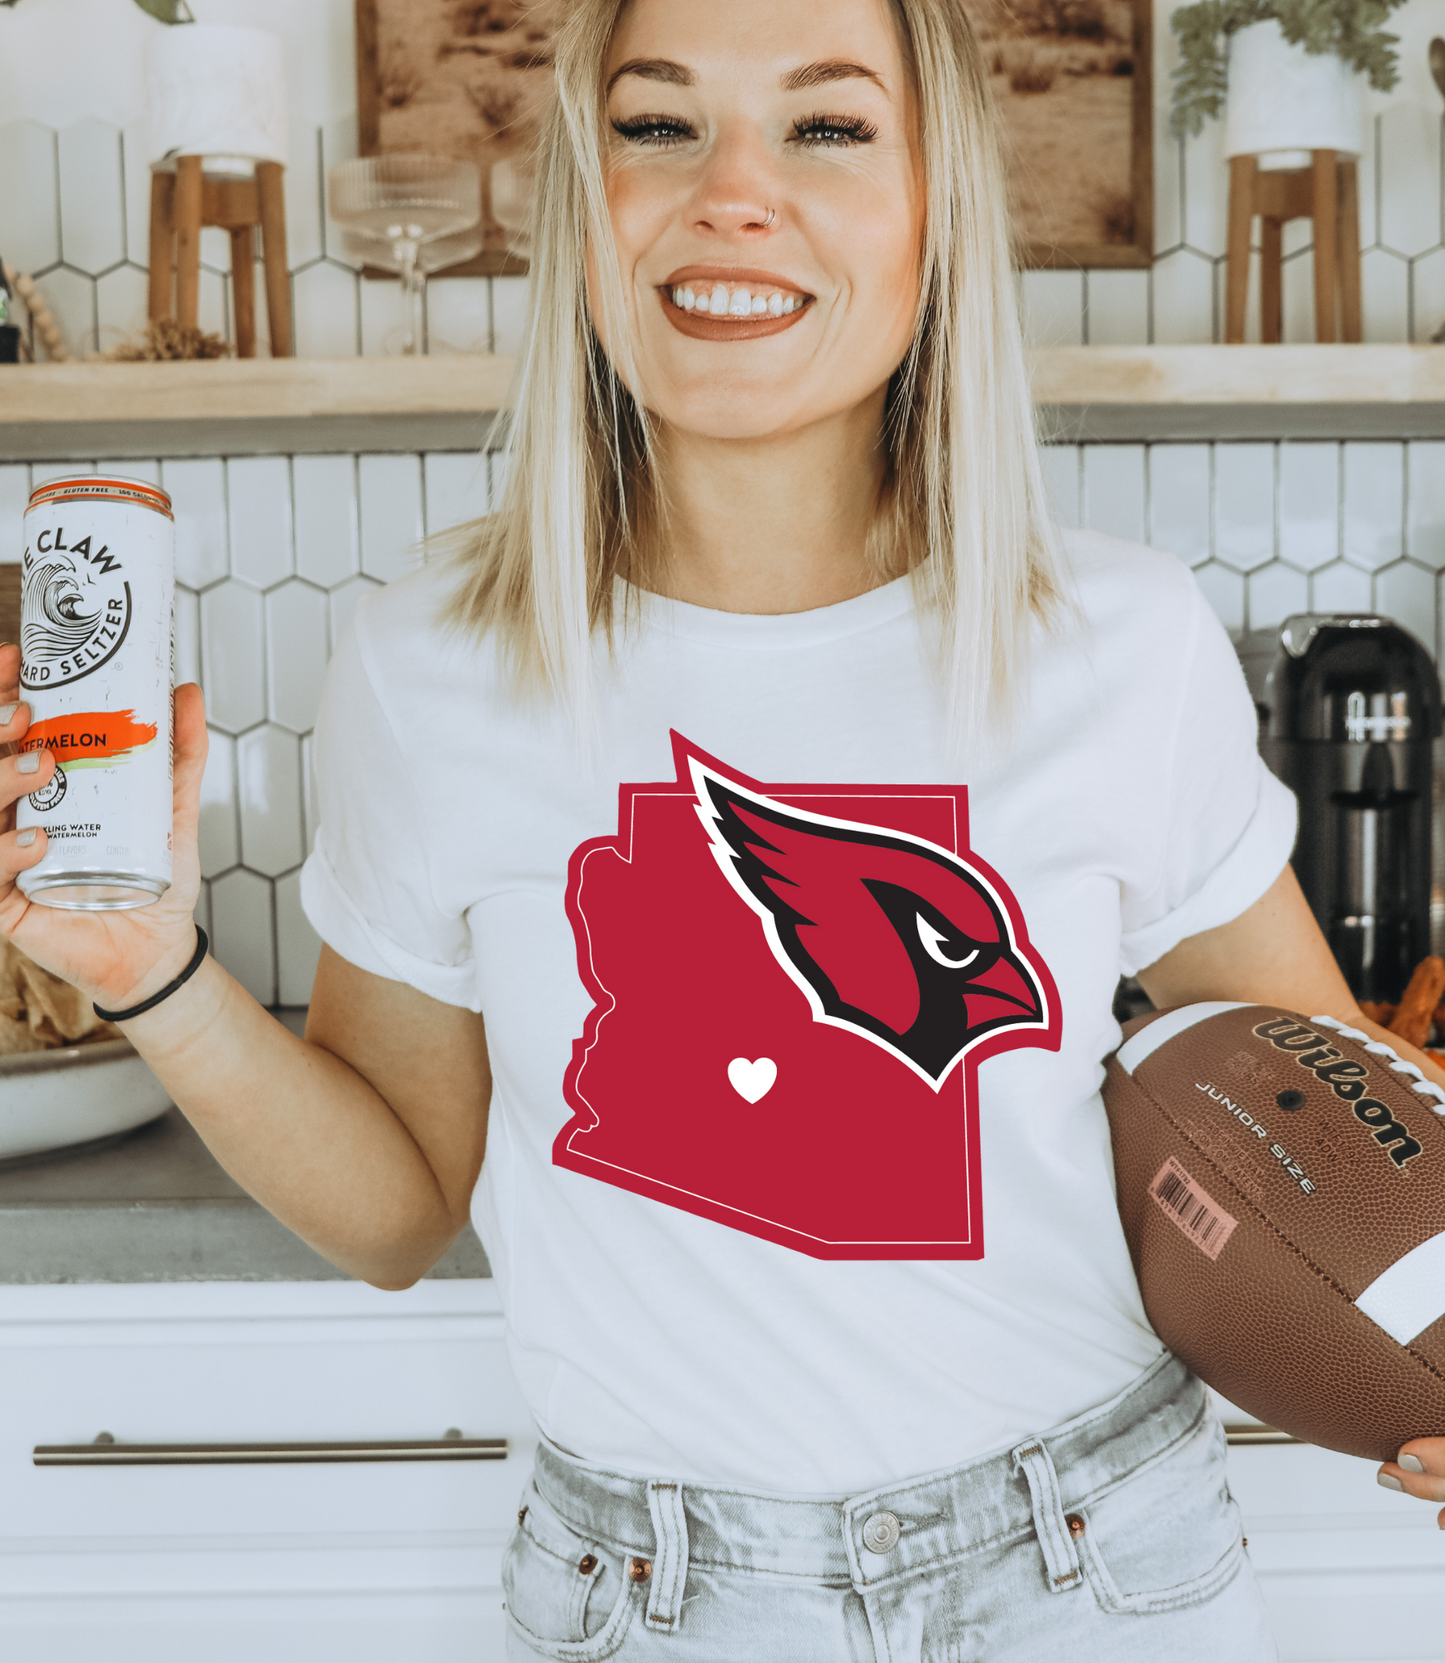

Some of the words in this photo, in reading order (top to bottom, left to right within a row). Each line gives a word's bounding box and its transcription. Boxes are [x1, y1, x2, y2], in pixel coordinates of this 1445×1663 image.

[37, 527, 122, 575] CLAW
[60, 599, 123, 675] SELTZER
[50, 788, 65, 808] FREE
[43, 825, 67, 834] KLING
[69, 823, 102, 833] WATER
[1252, 1015, 1422, 1168] Wilson
[1195, 1082, 1267, 1139] JUNIOR
[1270, 1143, 1316, 1195] SIZE
[1199, 1116, 1224, 1140] MADE
[1230, 1145, 1266, 1180] VIETNAM
[1314, 1139, 1340, 1162] ADW
[1318, 1118, 1360, 1165] WTF1792
